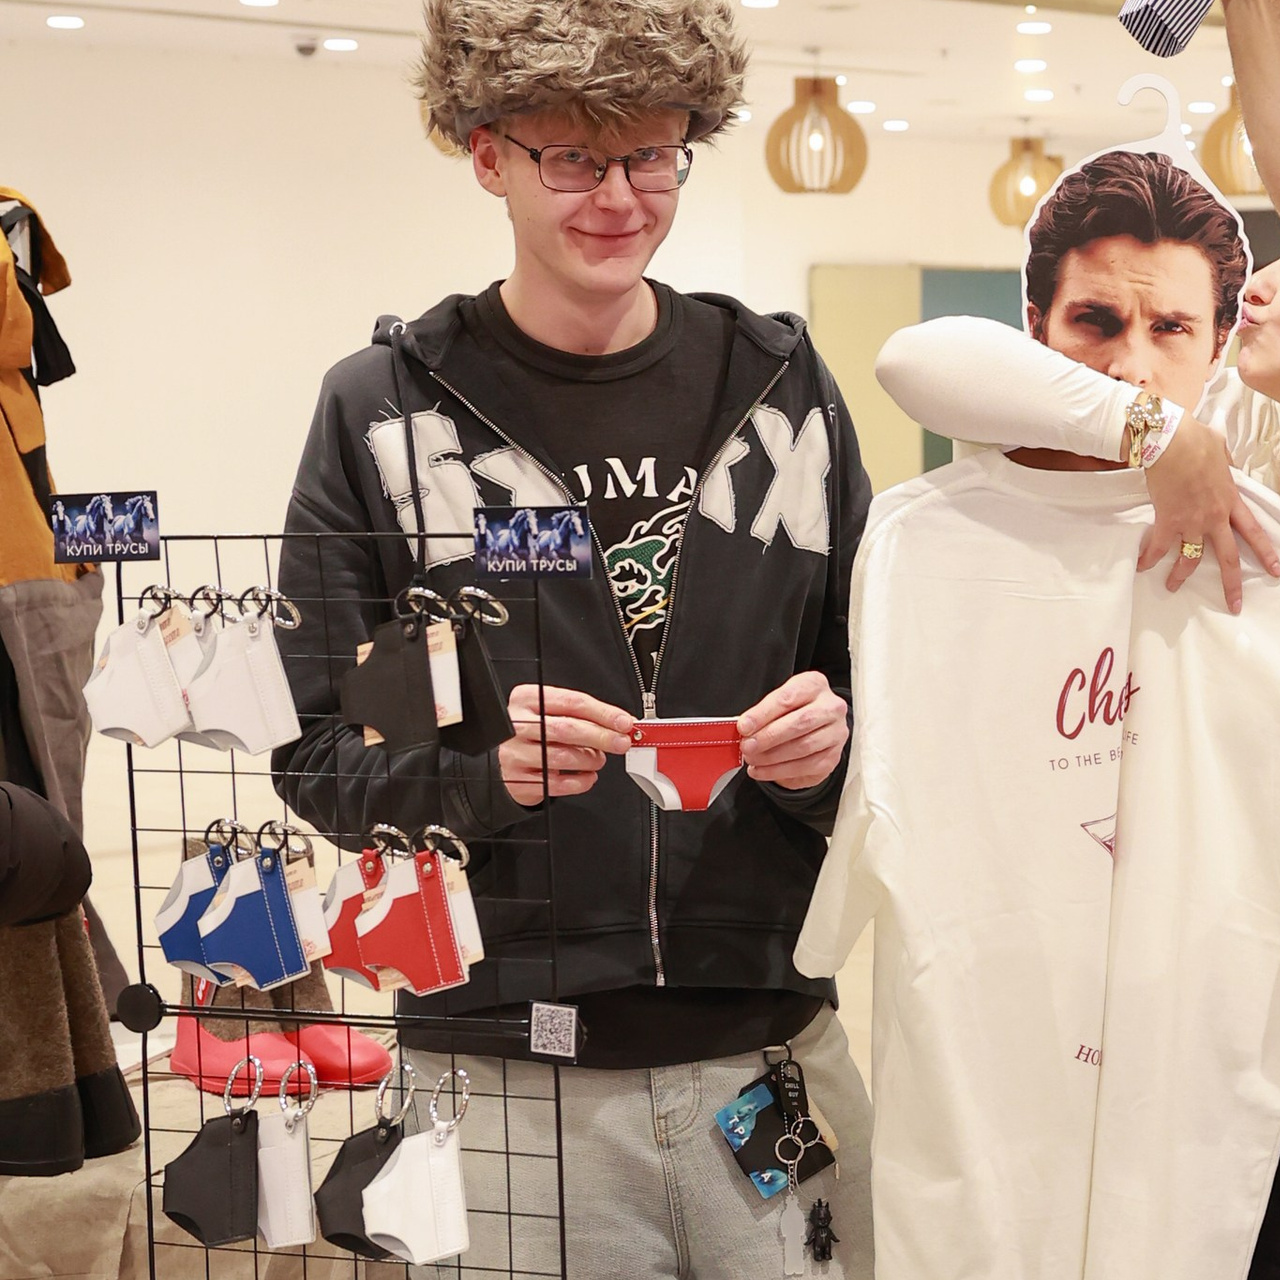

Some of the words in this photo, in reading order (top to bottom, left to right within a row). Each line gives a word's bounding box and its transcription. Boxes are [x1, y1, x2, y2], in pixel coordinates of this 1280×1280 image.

[66, 543, 103, 557] КУПИ
[107, 542, 149, 556] ТРУСЫ
[487, 560, 527, 572] КУПИ
[530, 559, 577, 572] ТРУСЫ
[1049, 757, 1070, 772] TO
[1075, 751, 1103, 768] THE
